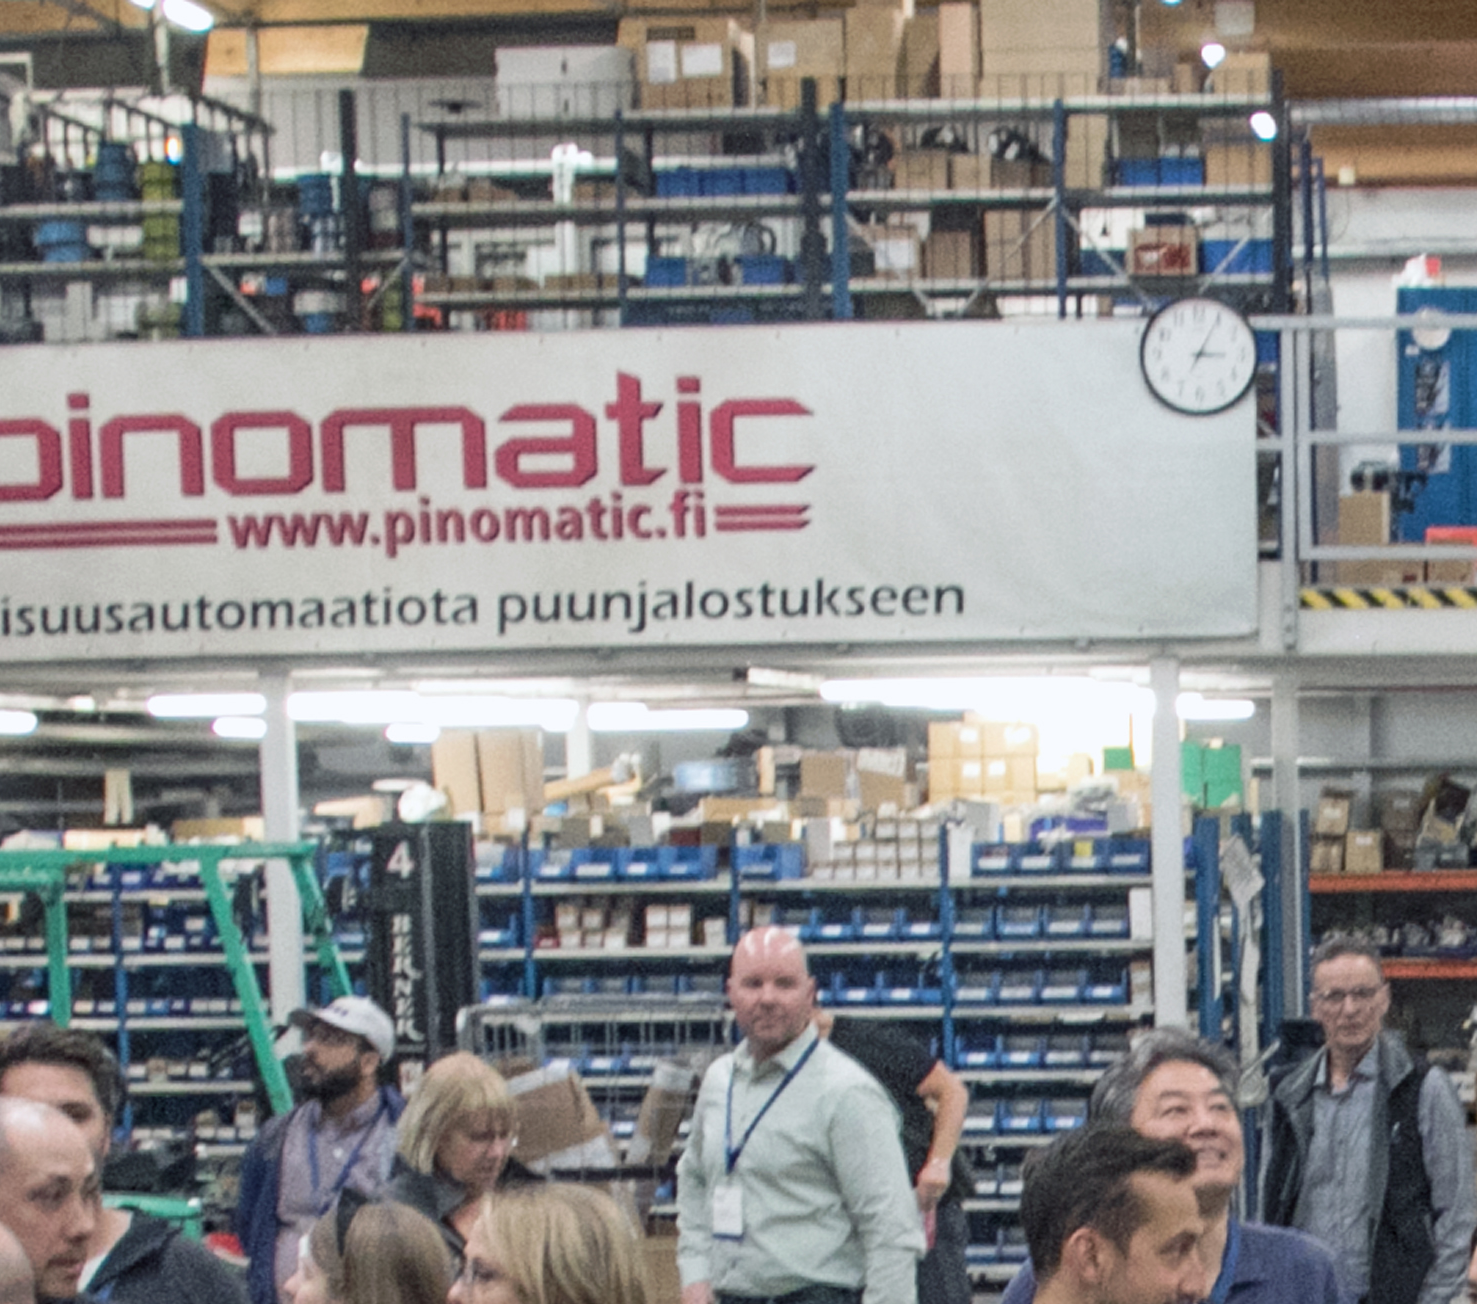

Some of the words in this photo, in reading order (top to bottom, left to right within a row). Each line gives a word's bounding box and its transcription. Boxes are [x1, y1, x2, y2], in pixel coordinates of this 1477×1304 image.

[227, 489, 707, 557] www.pinomatic.fi
[496, 578, 967, 634] puunjalostukseen
[386, 840, 415, 880] 4
